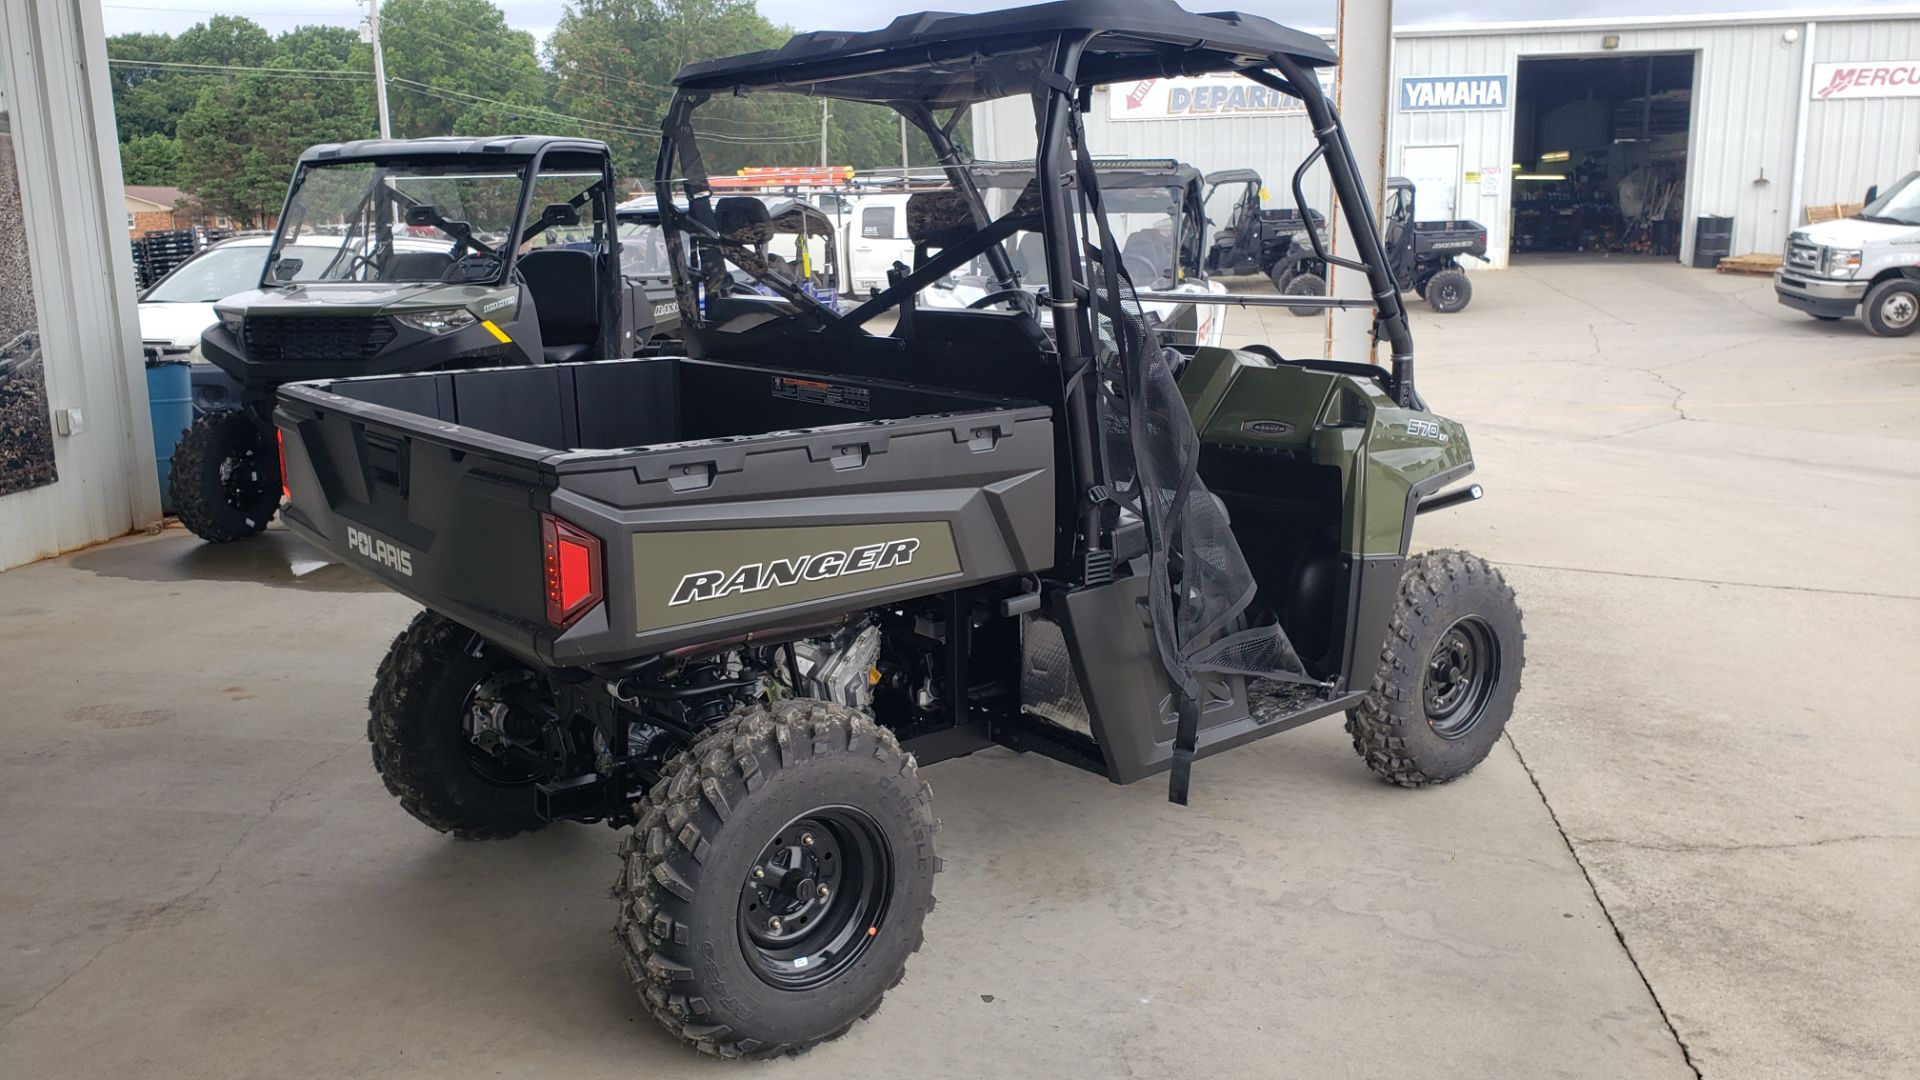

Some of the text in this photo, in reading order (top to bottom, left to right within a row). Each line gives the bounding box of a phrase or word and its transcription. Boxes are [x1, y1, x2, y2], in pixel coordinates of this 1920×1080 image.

[1405, 80, 1503, 107] YAMAHA
[1407, 418, 1440, 438] 570
[347, 526, 413, 577] POLARIS
[668, 538, 920, 606] RANGER
